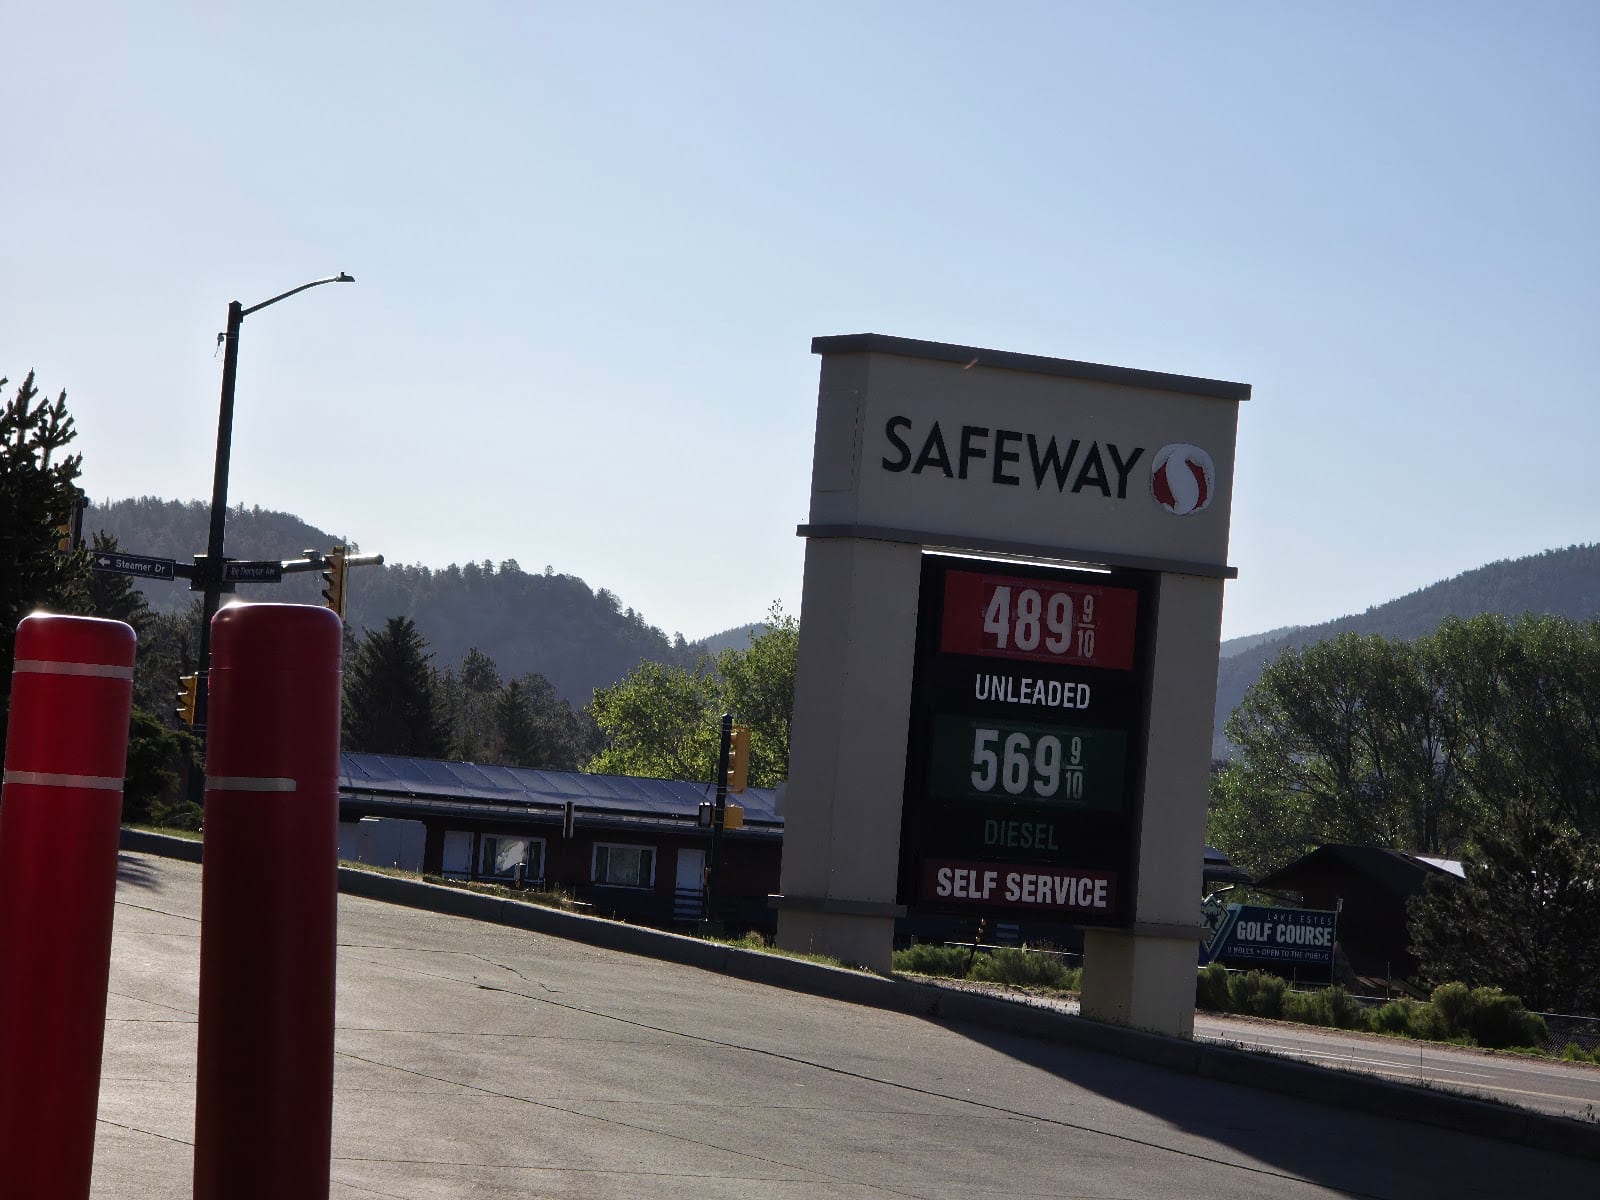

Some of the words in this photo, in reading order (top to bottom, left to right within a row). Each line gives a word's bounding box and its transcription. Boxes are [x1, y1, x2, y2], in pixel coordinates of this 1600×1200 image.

[881, 415, 1145, 499] SAFEWAY
[115, 559, 151, 571] Steamer
[155, 564, 166, 573] Dr
[983, 585, 1074, 654] 489
[975, 673, 1091, 710] UNLEADED
[971, 728, 1062, 797] 569
[984, 819, 1058, 850] DIESEL
[936, 867, 998, 899] SELF
[1005, 872, 1107, 908] SERVICE
[1237, 920, 1273, 942] GOLF
[1276, 923, 1332, 947] COURSE
